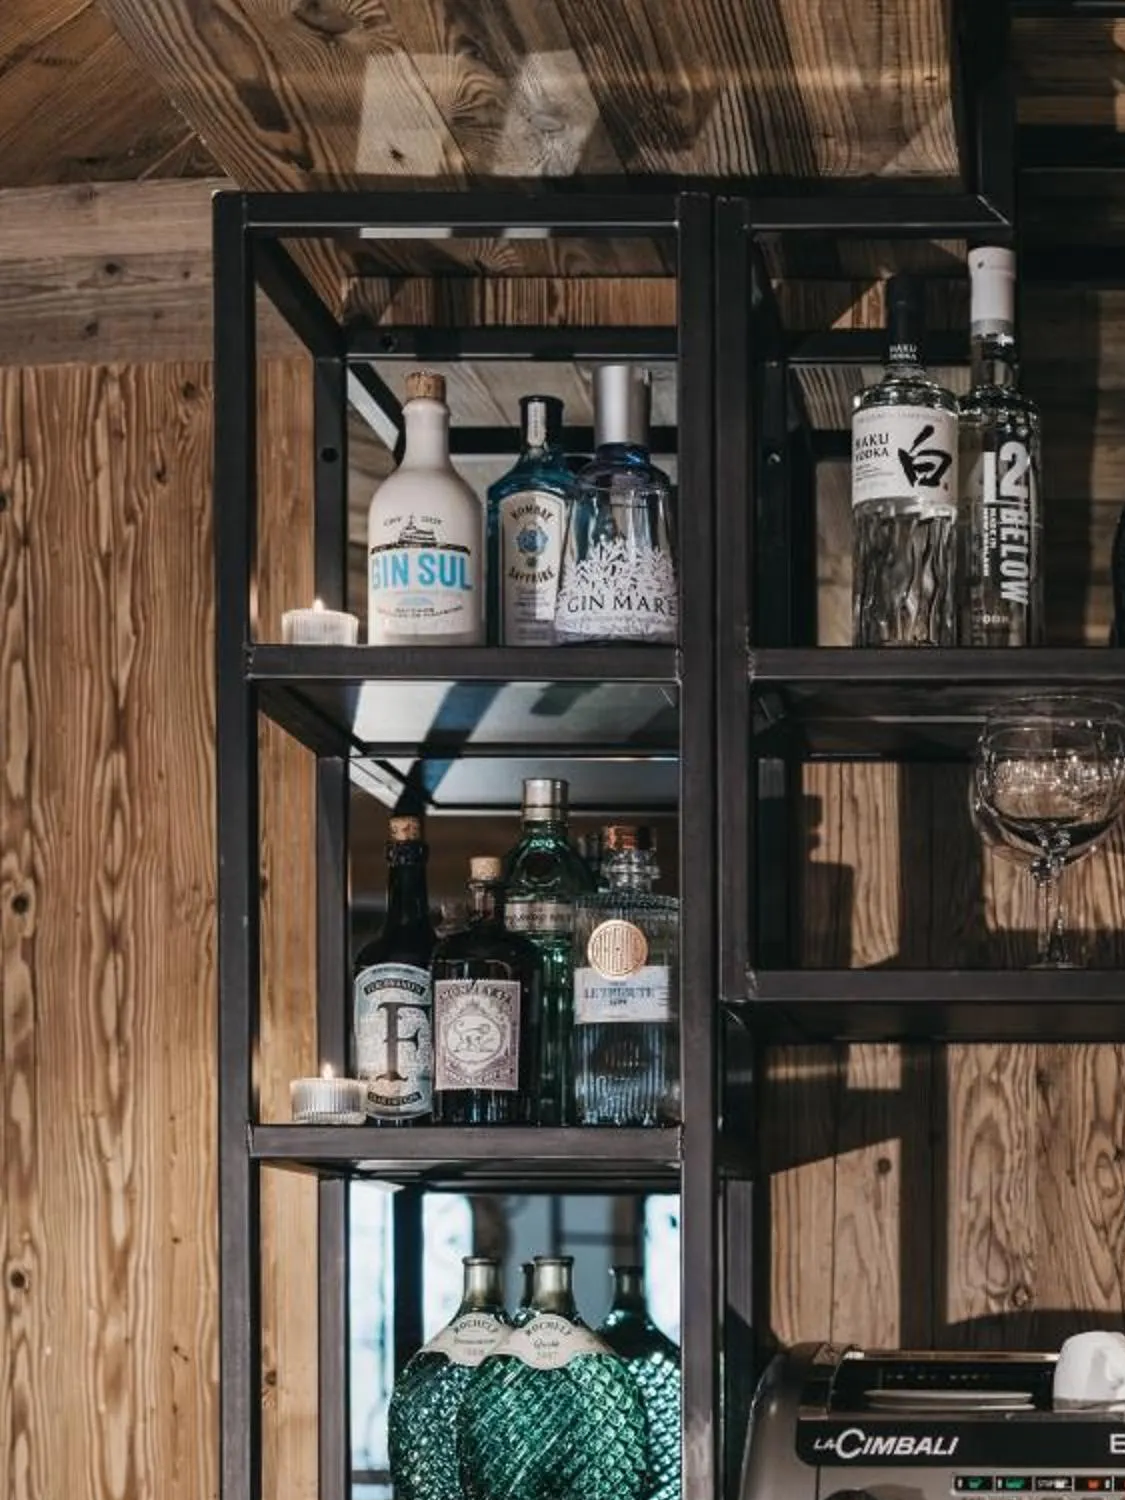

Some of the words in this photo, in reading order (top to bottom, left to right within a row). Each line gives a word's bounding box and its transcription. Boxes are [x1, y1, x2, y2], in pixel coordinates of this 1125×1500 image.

[372, 553, 409, 589] GIN
[418, 552, 473, 590] SUL
[1000, 504, 1029, 605] BELOW
[567, 594, 604, 612] GIN
[613, 594, 677, 616] MARE
[836, 1428, 959, 1459] CIMBALI
